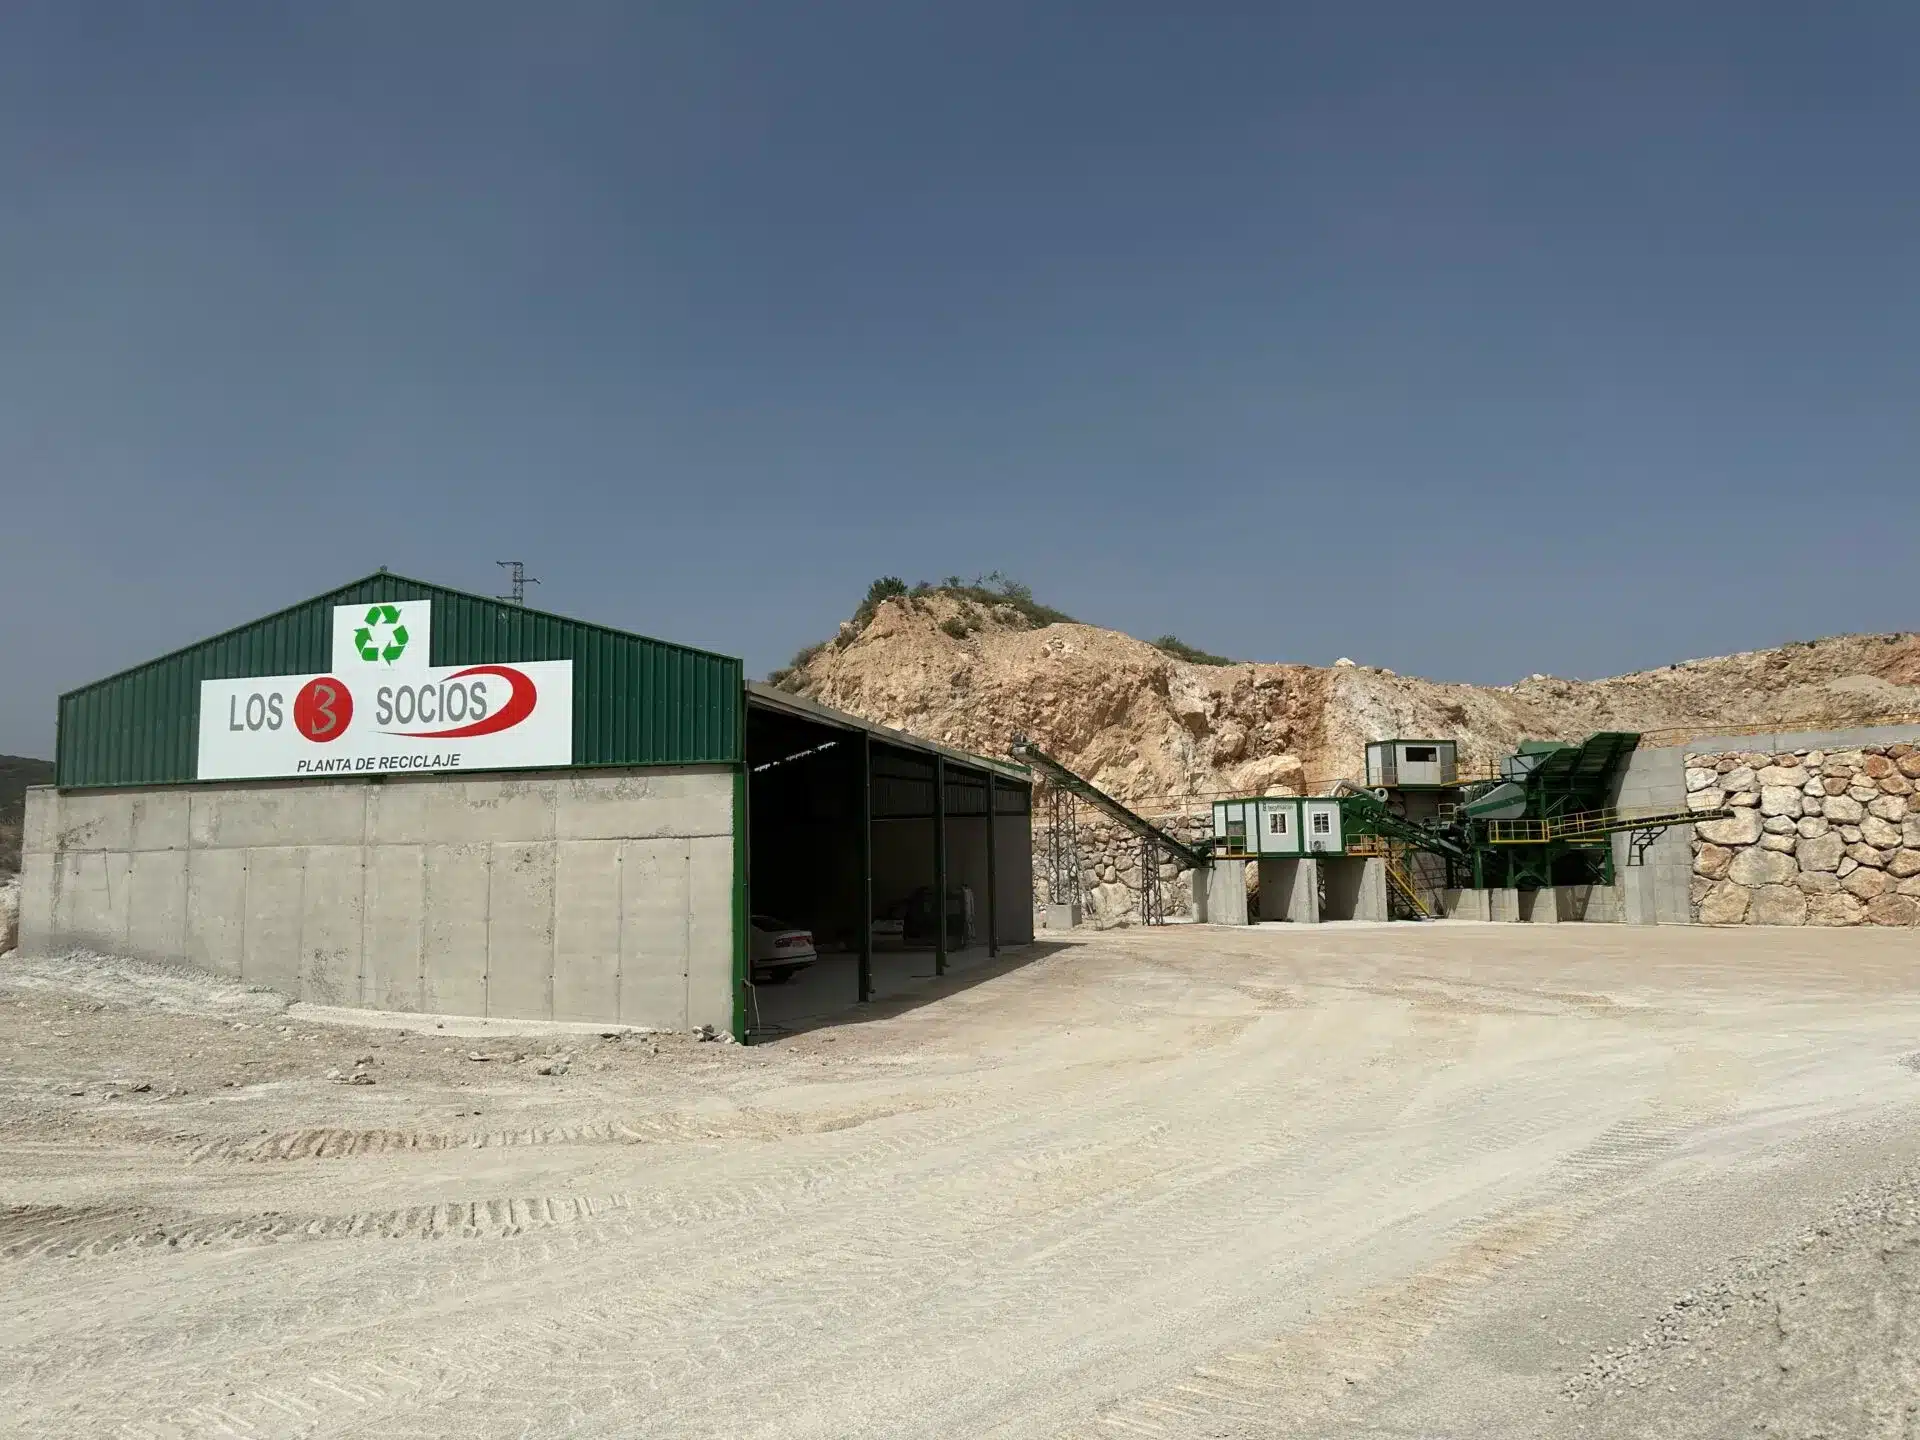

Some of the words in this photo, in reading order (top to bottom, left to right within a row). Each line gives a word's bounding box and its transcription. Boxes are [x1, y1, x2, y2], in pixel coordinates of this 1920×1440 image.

[229, 692, 284, 731] LOS
[311, 684, 337, 734] 3
[375, 681, 487, 725] SOCIOS
[297, 758, 351, 772] PLANTA
[355, 757, 376, 770] DE
[378, 753, 461, 769] RECICLAJE
